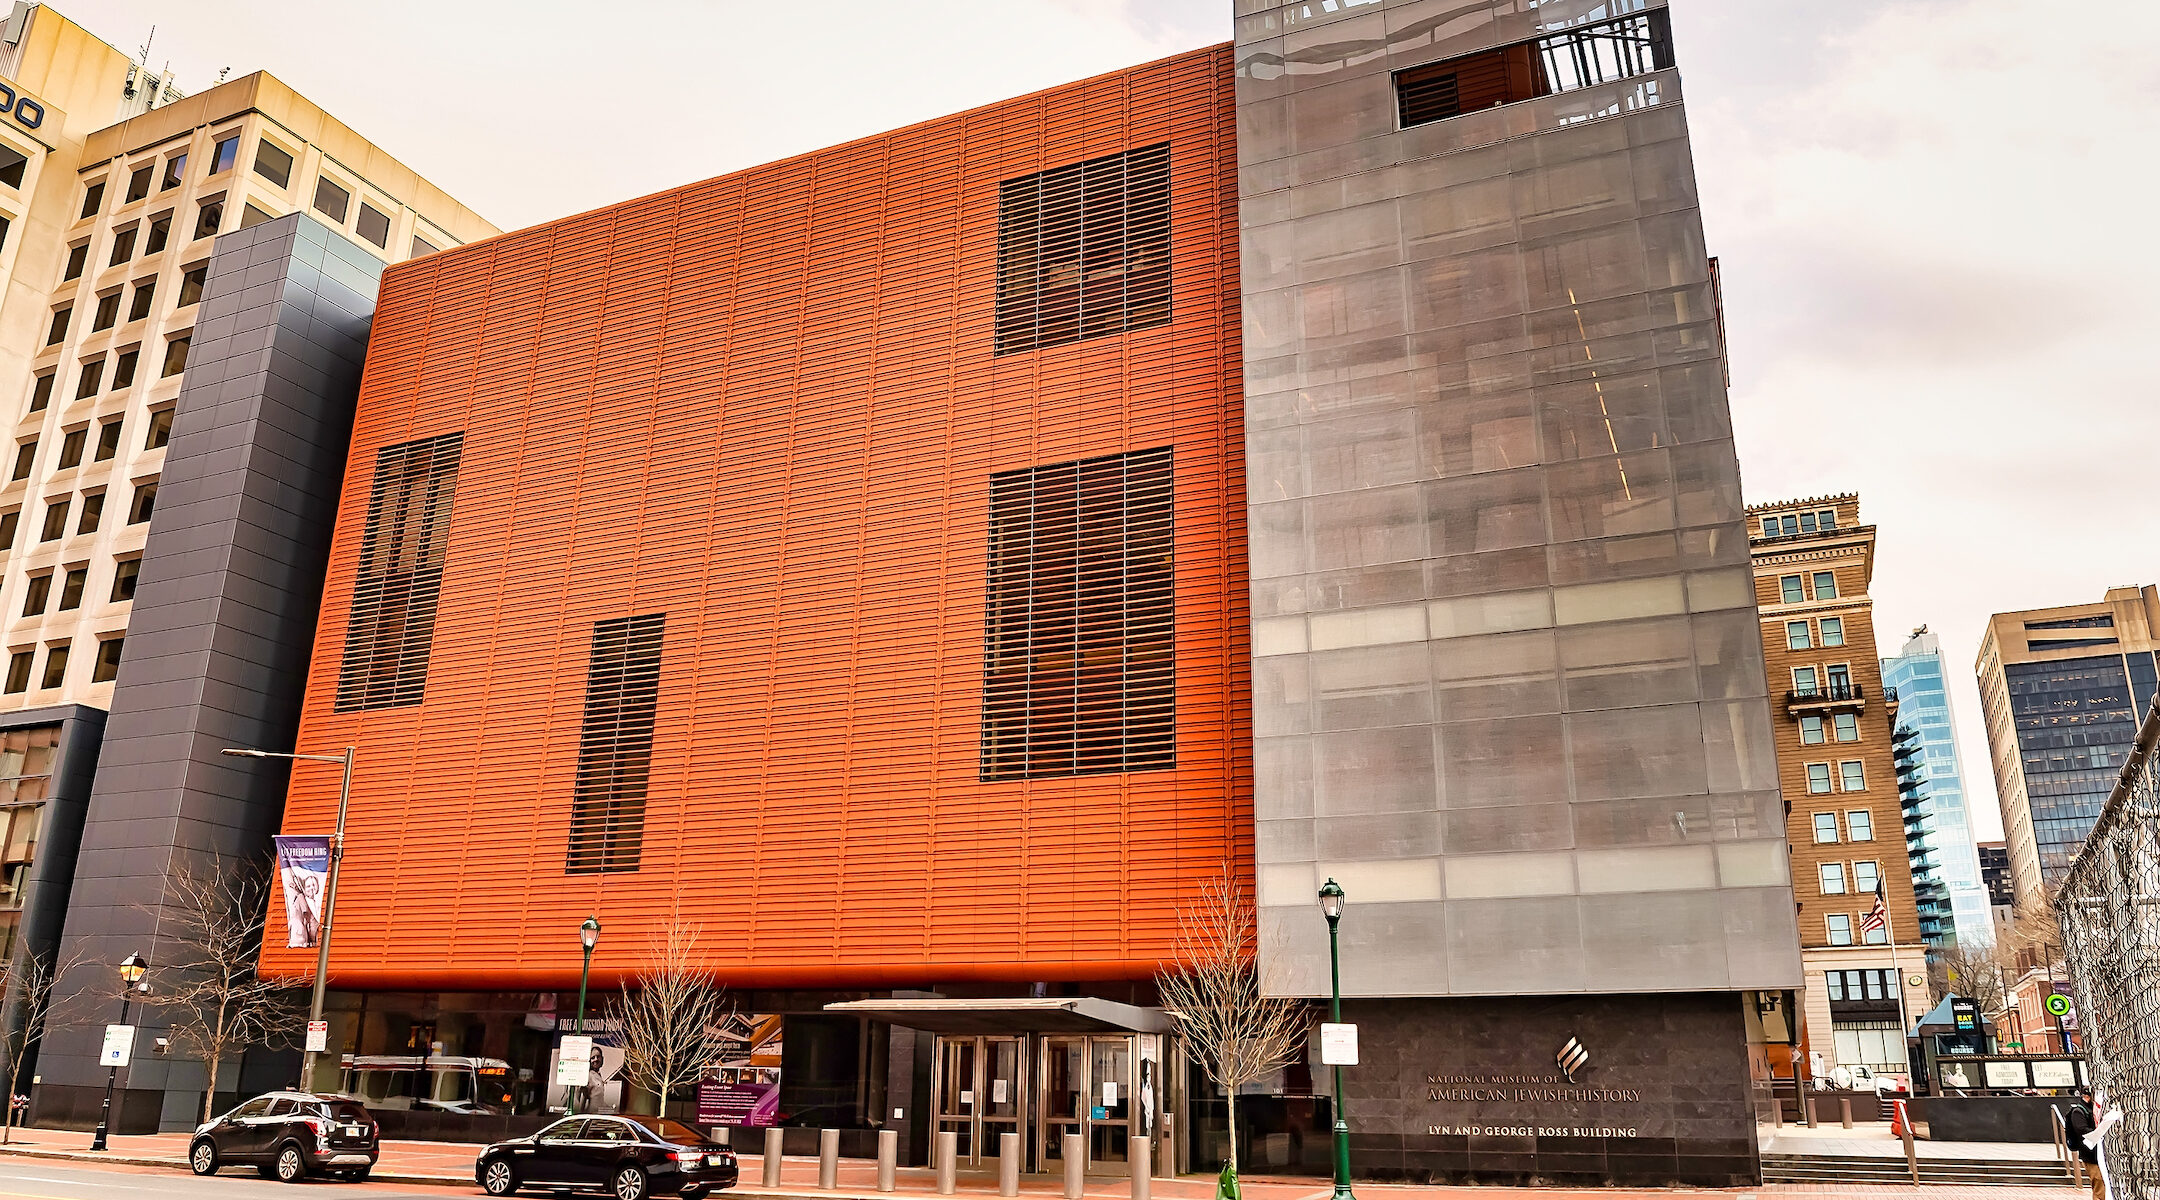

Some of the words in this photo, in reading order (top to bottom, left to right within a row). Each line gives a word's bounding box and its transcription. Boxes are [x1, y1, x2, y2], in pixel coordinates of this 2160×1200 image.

[559, 1019, 572, 1031] FREE
[1427, 1075, 1485, 1083] NATIONAL
[1491, 1075, 1540, 1083] MUSEUM
[1544, 1075, 1559, 1083] OF
[1428, 1088, 1508, 1101] AMERICAN
[1514, 1088, 1568, 1103] JEWISH
[1575, 1088, 1641, 1101] HISTORY
[1428, 1125, 1450, 1135] LYN
[1454, 1126, 1481, 1136] AND
[1484, 1126, 1534, 1136] GEORGE
[1538, 1127, 1568, 1137] ROSS
[1573, 1127, 1637, 1138] BUILDING
